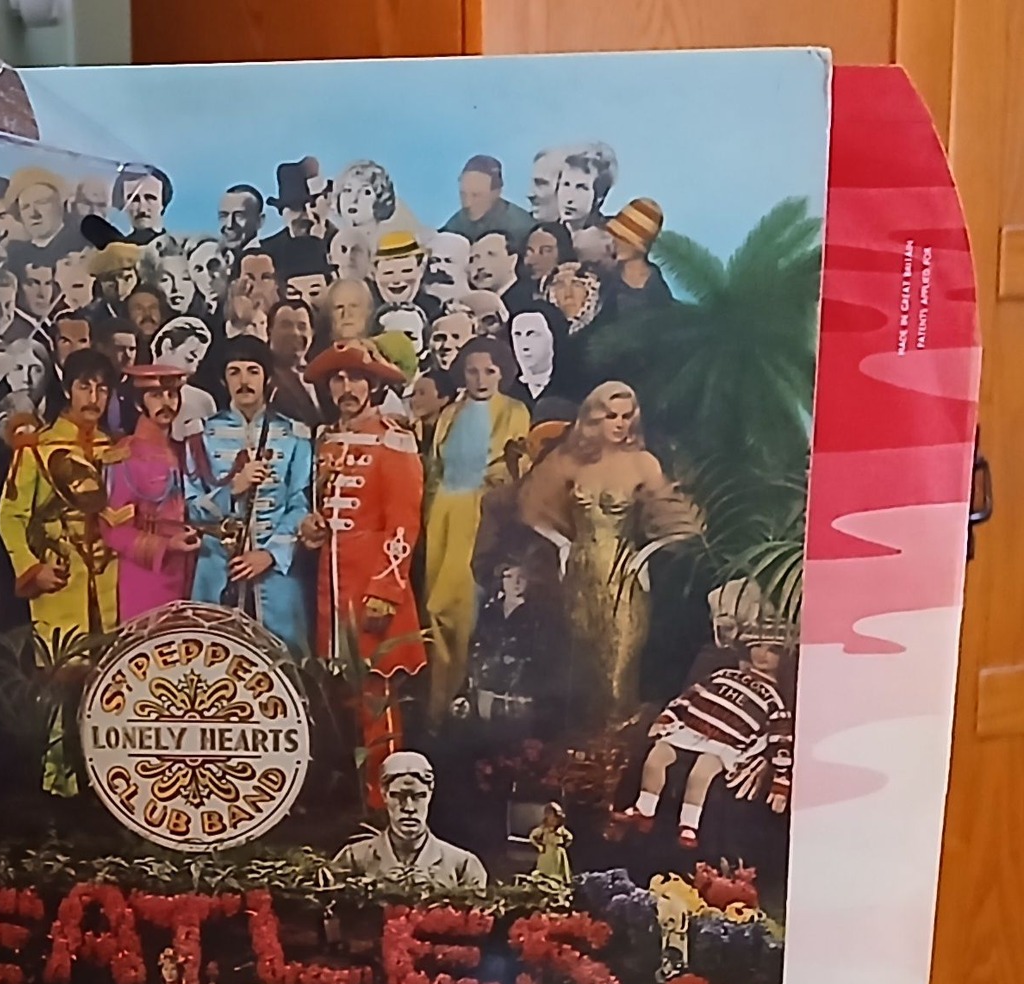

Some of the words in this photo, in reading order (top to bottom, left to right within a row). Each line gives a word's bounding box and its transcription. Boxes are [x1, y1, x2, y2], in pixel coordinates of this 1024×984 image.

[902, 240, 914, 277] BRITAIN
[922, 247, 932, 266] FOR
[900, 281, 911, 311] GREAT
[920, 268, 931, 305] APPLIED
[899, 314, 909, 326] IN
[917, 308, 929, 348] PATENTS
[897, 330, 909, 356] MADE
[128, 638, 288, 720] PEPPERS
[91, 725, 188, 751] LONELY
[199, 727, 300, 753] HEARTS
[106, 765, 191, 836] CLUB
[201, 767, 287, 835] BAND
